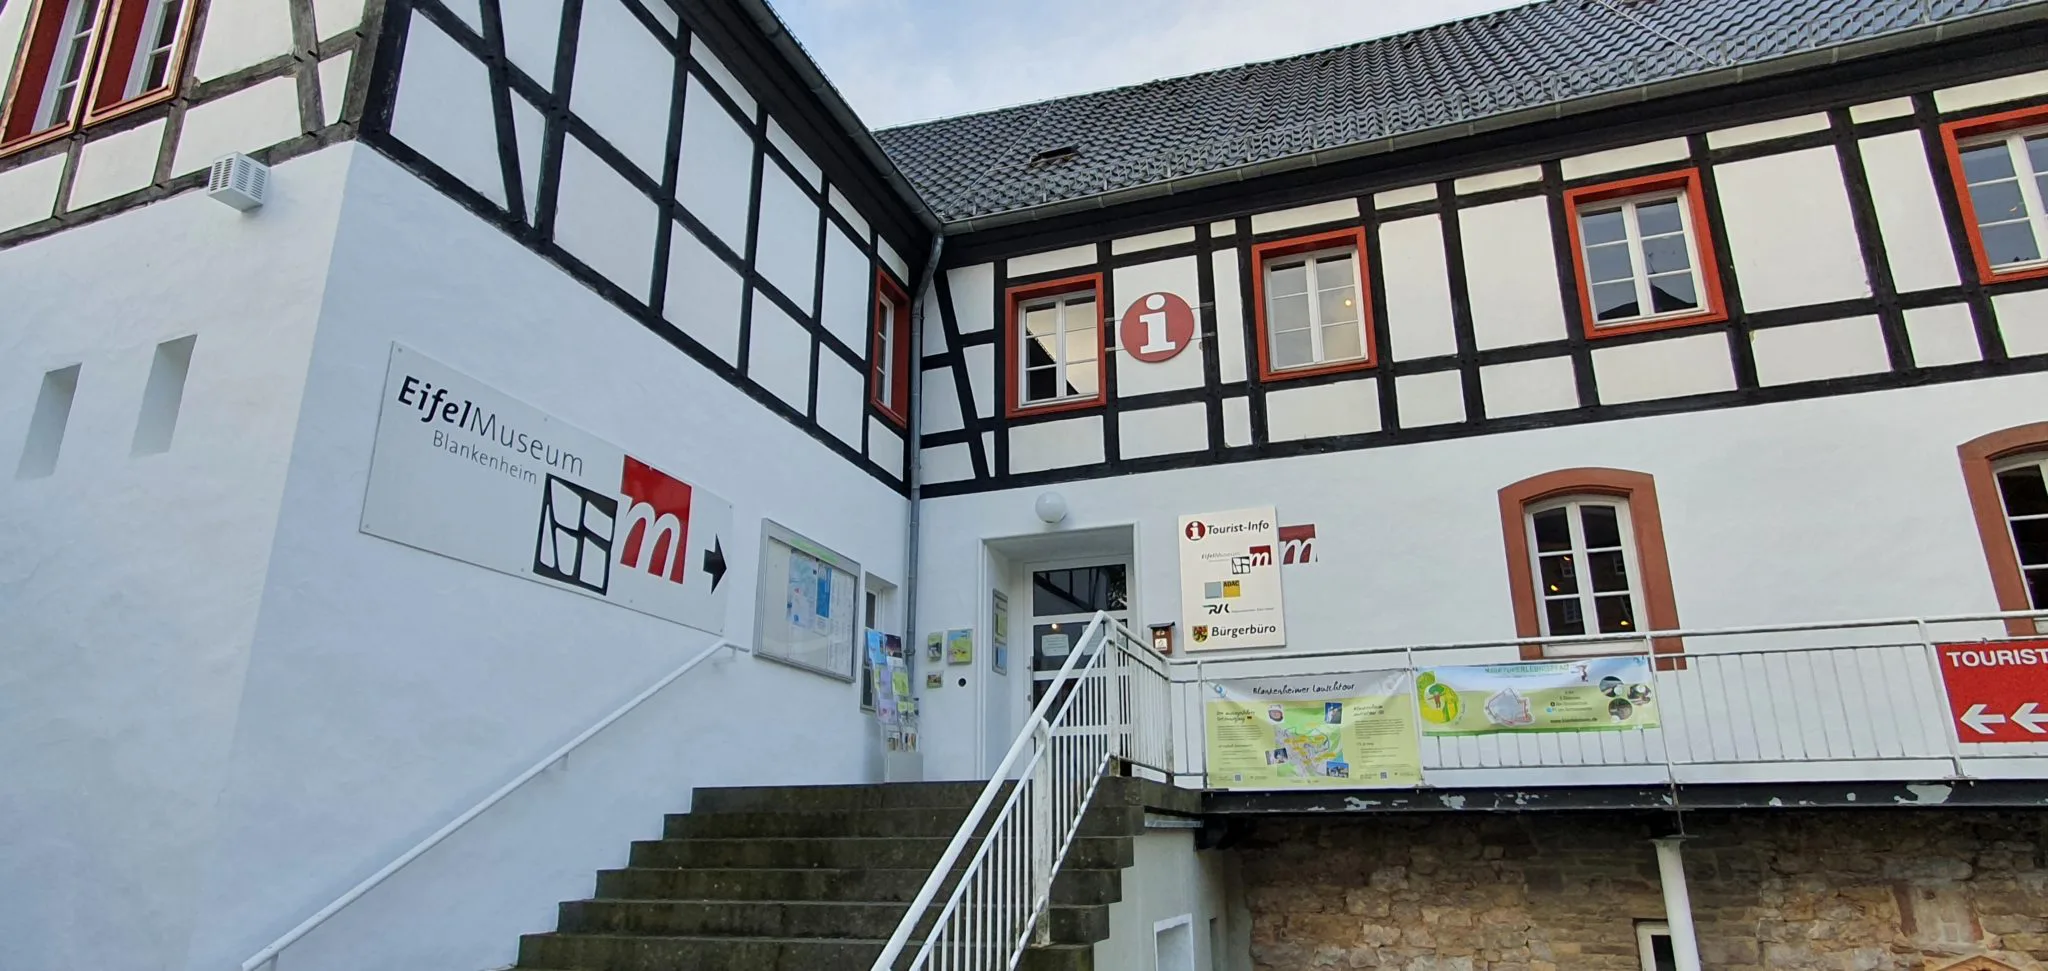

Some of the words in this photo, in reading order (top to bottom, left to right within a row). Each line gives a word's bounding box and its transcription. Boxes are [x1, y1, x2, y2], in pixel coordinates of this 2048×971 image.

[397, 374, 584, 477] EifelMuseum
[433, 430, 537, 484] Blankenheim
[1207, 520, 1270, 535] Tourist-Info
[1201, 551, 1241, 560] EifelM
[1223, 580, 1240, 588] ADAC
[1211, 623, 1277, 639] Bürgerbüro
[1946, 648, 2048, 667] TOURIST
[1253, 684, 1309, 695] Blankenheimer
